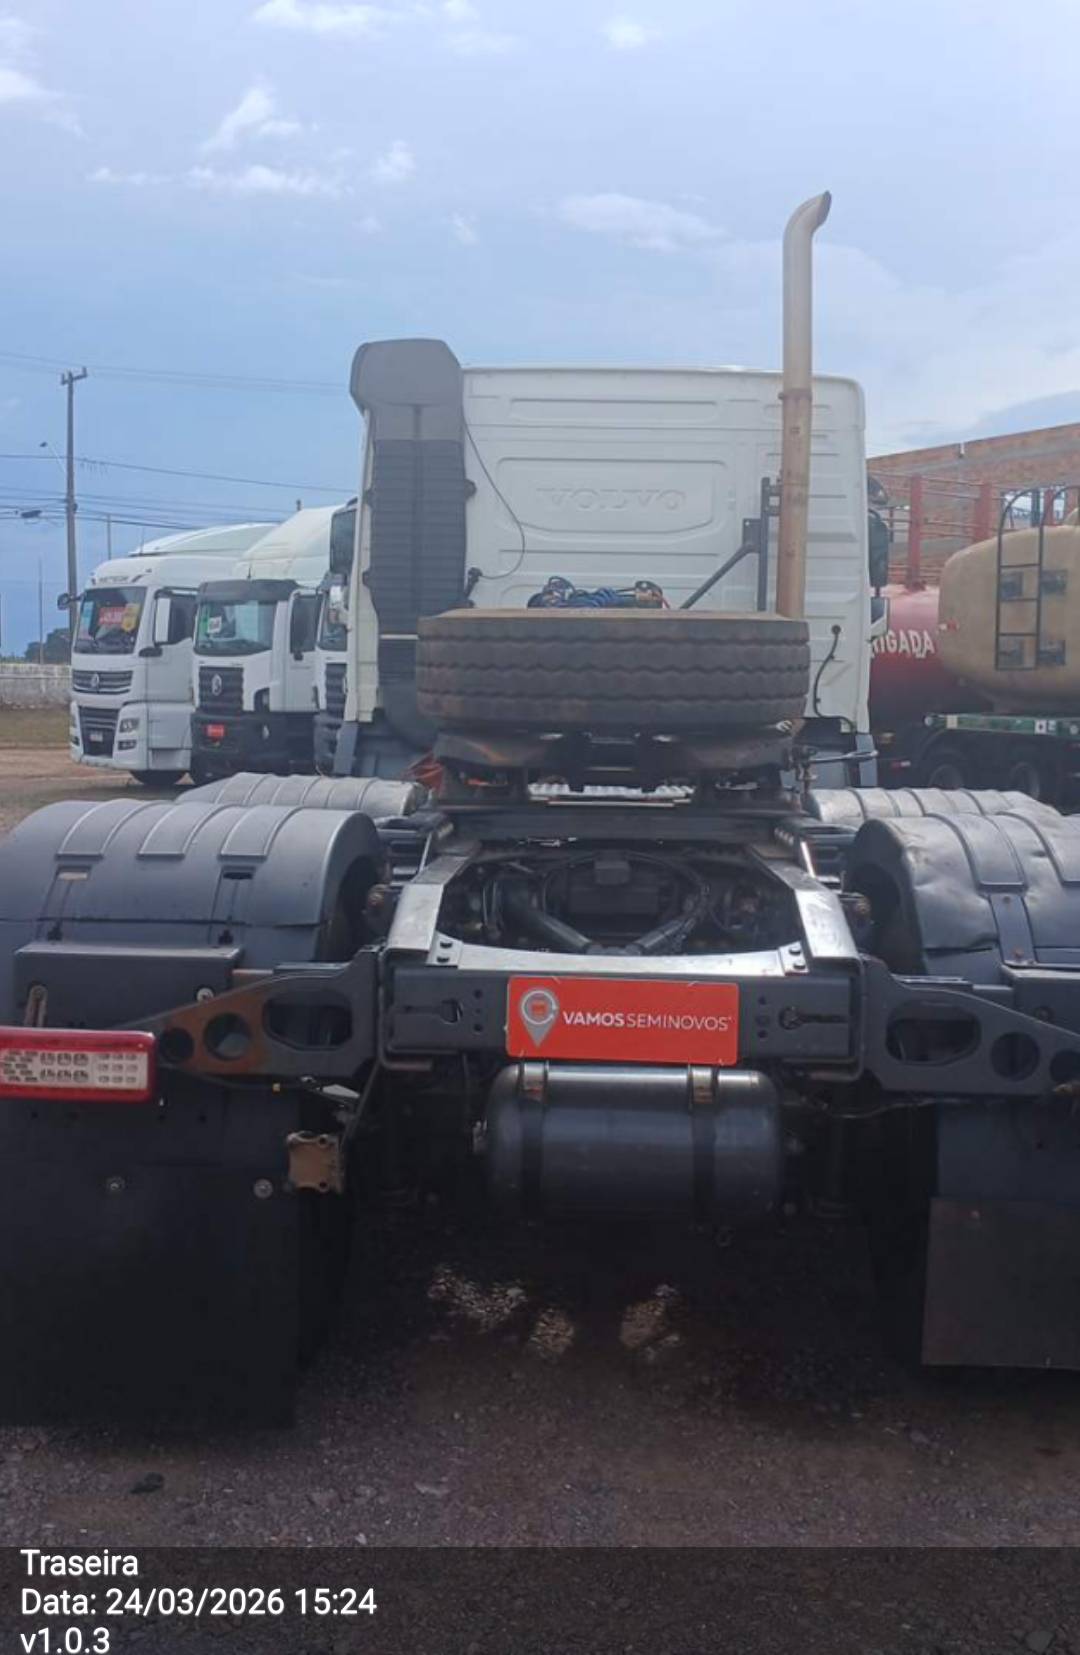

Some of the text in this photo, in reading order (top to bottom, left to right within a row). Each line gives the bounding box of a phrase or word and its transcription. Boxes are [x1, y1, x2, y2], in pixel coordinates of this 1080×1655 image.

[536, 487, 687, 512] VOLVO
[562, 1010, 728, 1032] VAMOS SEMINOVOS
